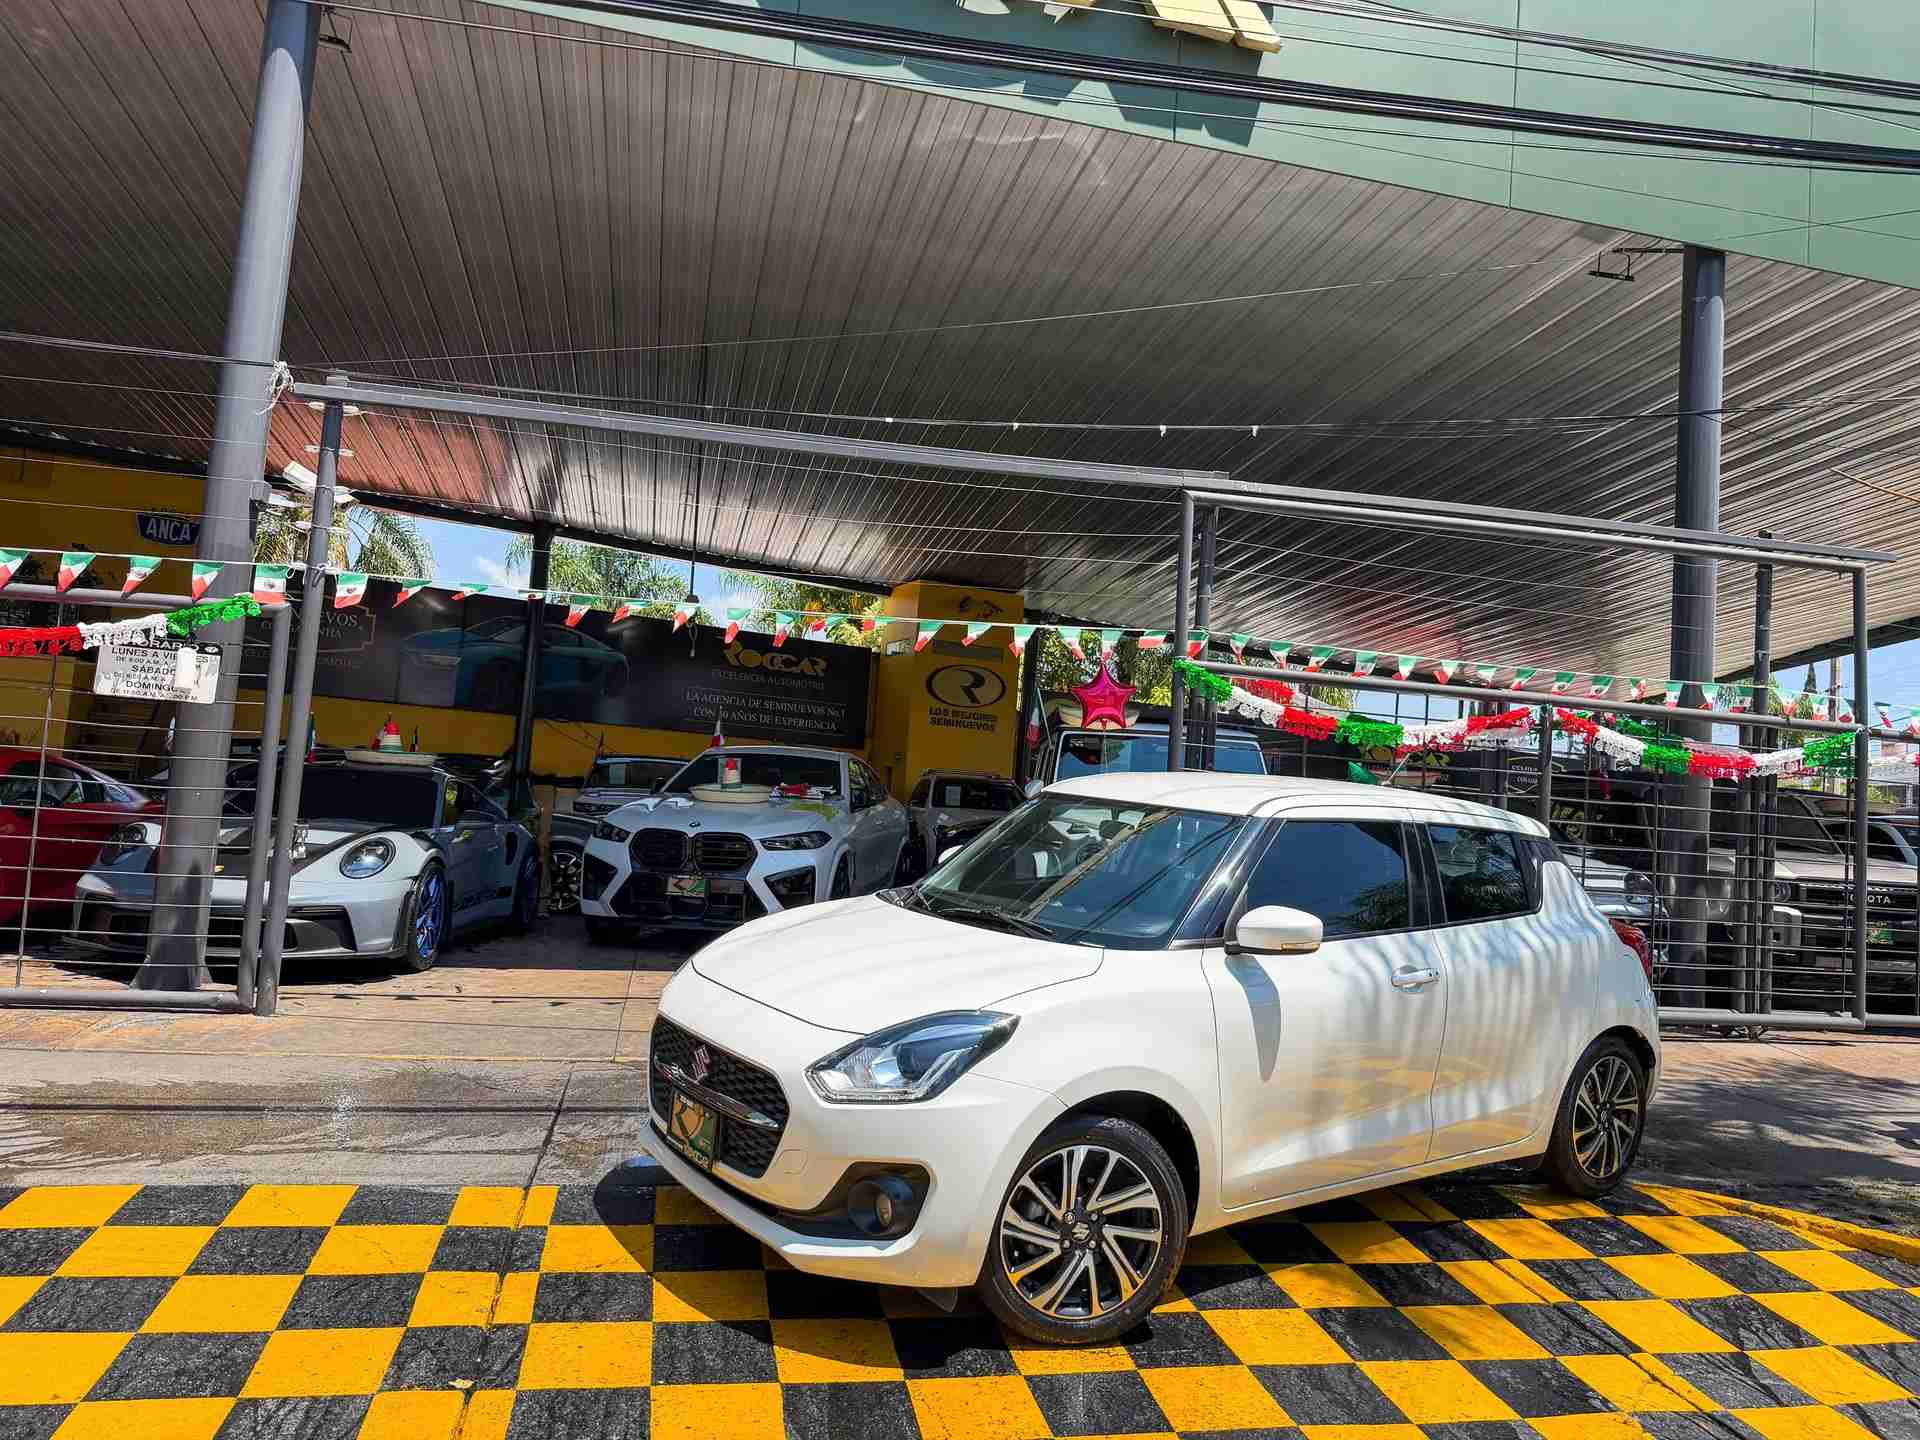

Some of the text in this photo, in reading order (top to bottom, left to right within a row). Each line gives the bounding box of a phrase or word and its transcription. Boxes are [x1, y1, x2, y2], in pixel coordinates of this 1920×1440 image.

[111, 647, 148, 658] LUNES
[151, 649, 160, 658] A
[701, 692, 748, 707] AGENCIA
[749, 697, 762, 708] DE
[763, 699, 826, 715] SEMINUEVOS
[929, 706, 949, 717] LOS
[730, 708, 758, 723] AÑOS
[759, 713, 773, 725] DE
[775, 714, 837, 731] EXPERIENCIA
[929, 716, 997, 732] SEMINUEVOS
